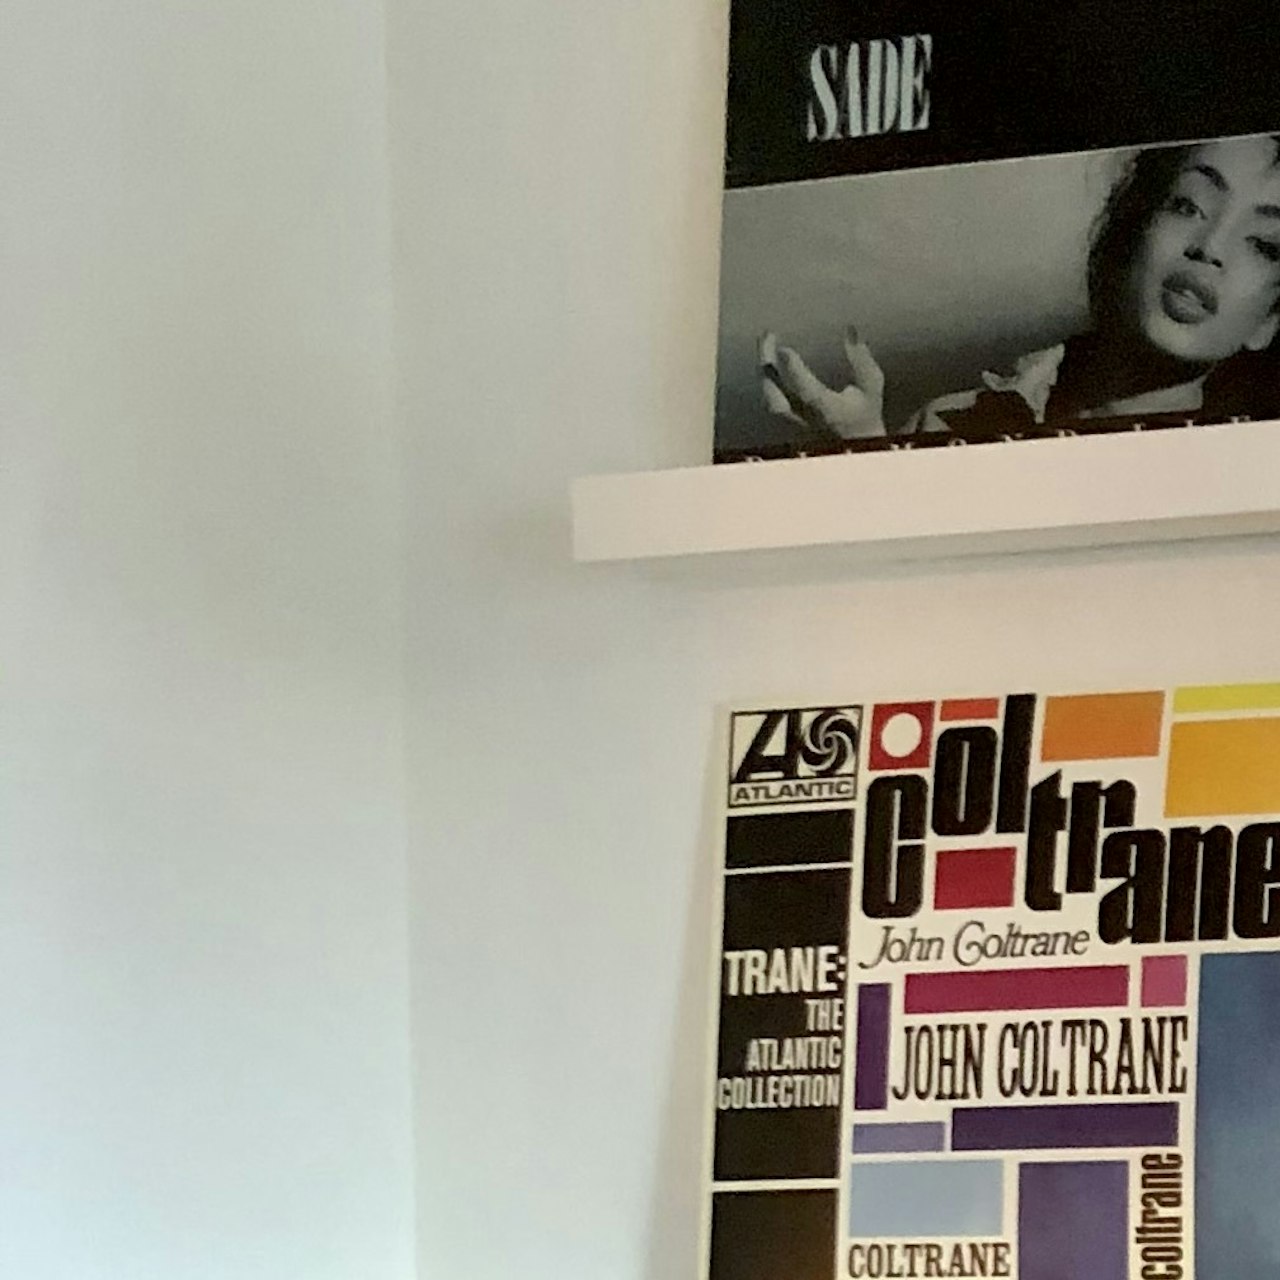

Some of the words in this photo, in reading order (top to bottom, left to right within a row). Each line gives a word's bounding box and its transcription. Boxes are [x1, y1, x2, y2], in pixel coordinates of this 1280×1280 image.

[807, 33, 933, 141] SADE
[735, 780, 852, 803] ATLANTIC
[858, 925, 945, 969] John
[953, 920, 1091, 967] Coltrane
[804, 998, 845, 1032] THE
[746, 1036, 842, 1072] ATLANTIC
[891, 1022, 986, 1101] JOHN
[999, 1014, 1188, 1097] COLTRANE
[717, 1074, 841, 1110] COLLECTION
[1135, 1153, 1183, 1280] coltrane
[848, 1243, 1010, 1279] COLTRANE
